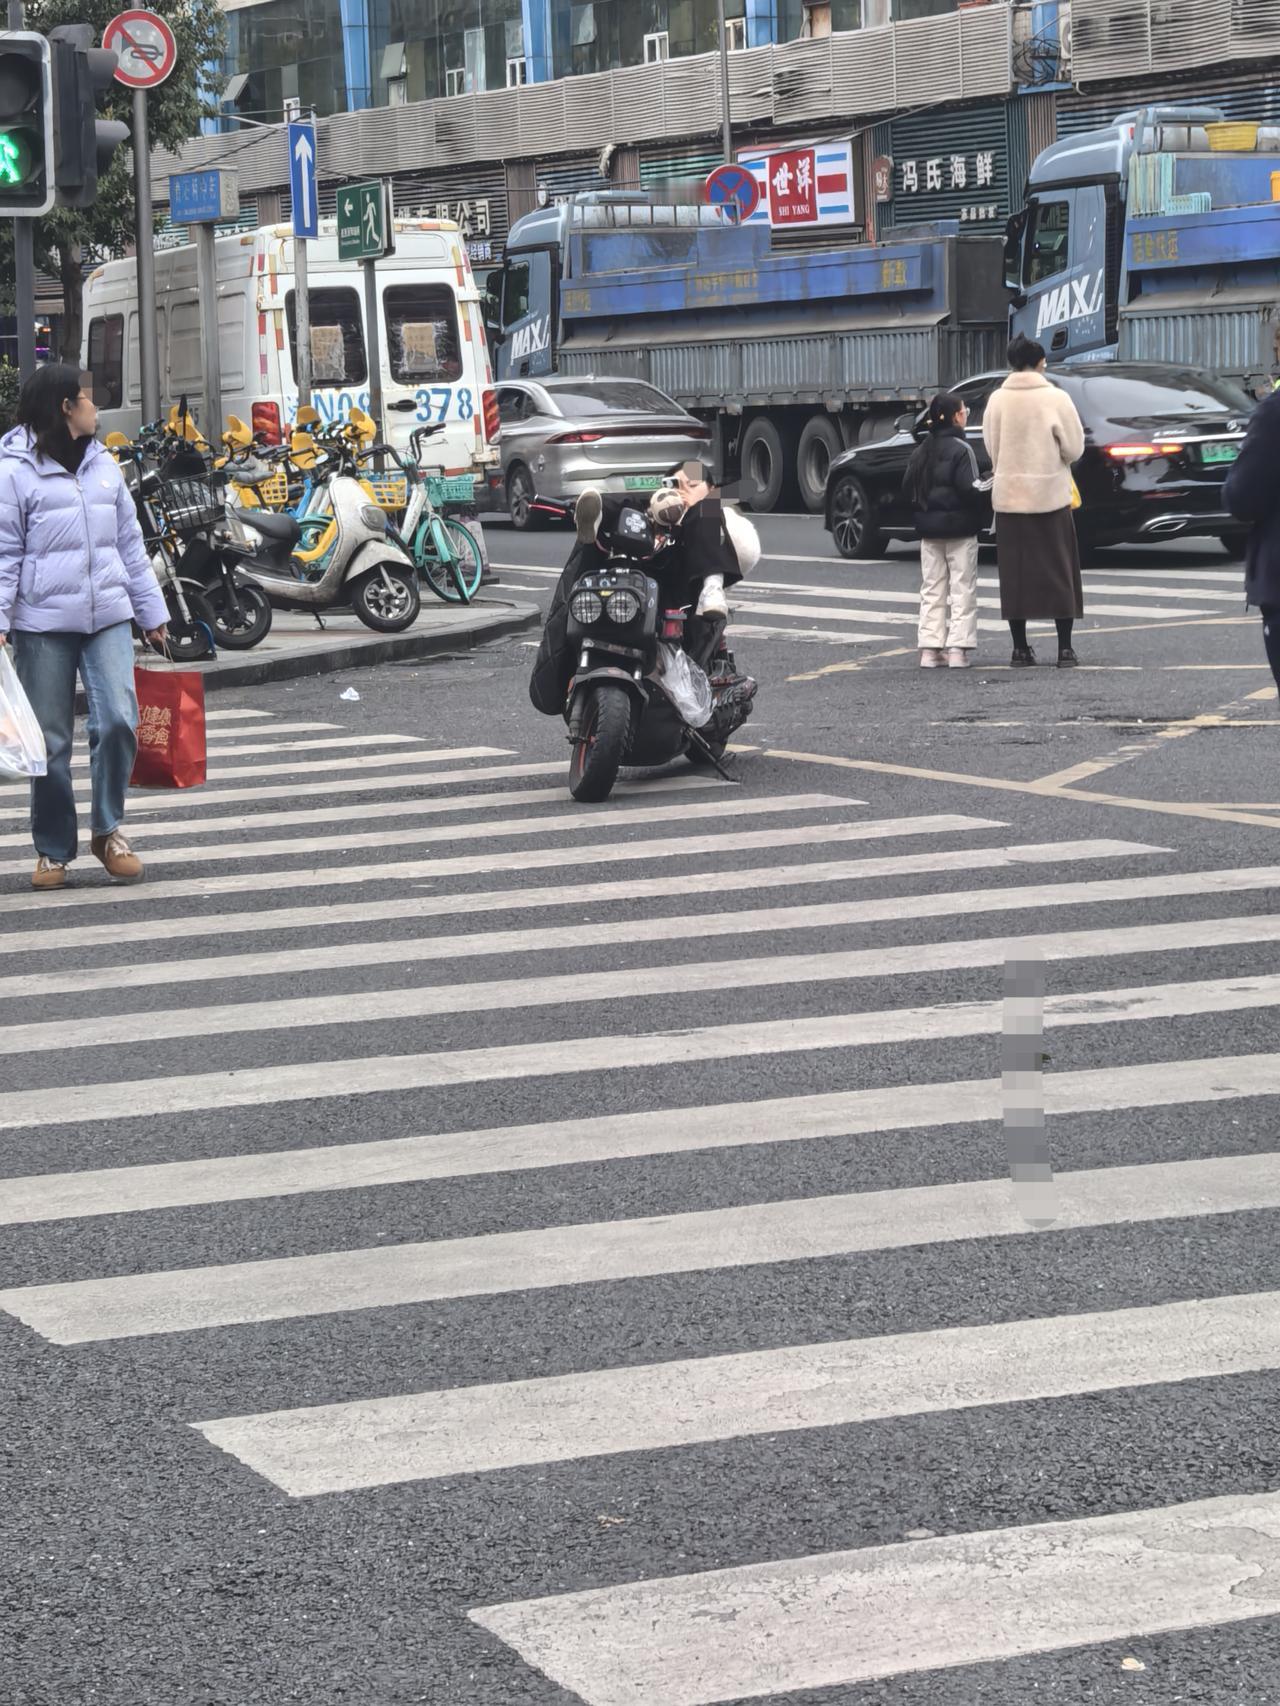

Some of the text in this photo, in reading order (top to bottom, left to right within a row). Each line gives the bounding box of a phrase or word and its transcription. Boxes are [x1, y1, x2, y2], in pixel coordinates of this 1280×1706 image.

[772, 157, 813, 200] 世洋
[902, 151, 994, 192] 冯氏海鲜
[778, 204, 810, 216] SHI YANG
[415, 388, 473, 422] 378
[140, 705, 171, 726] 健康
